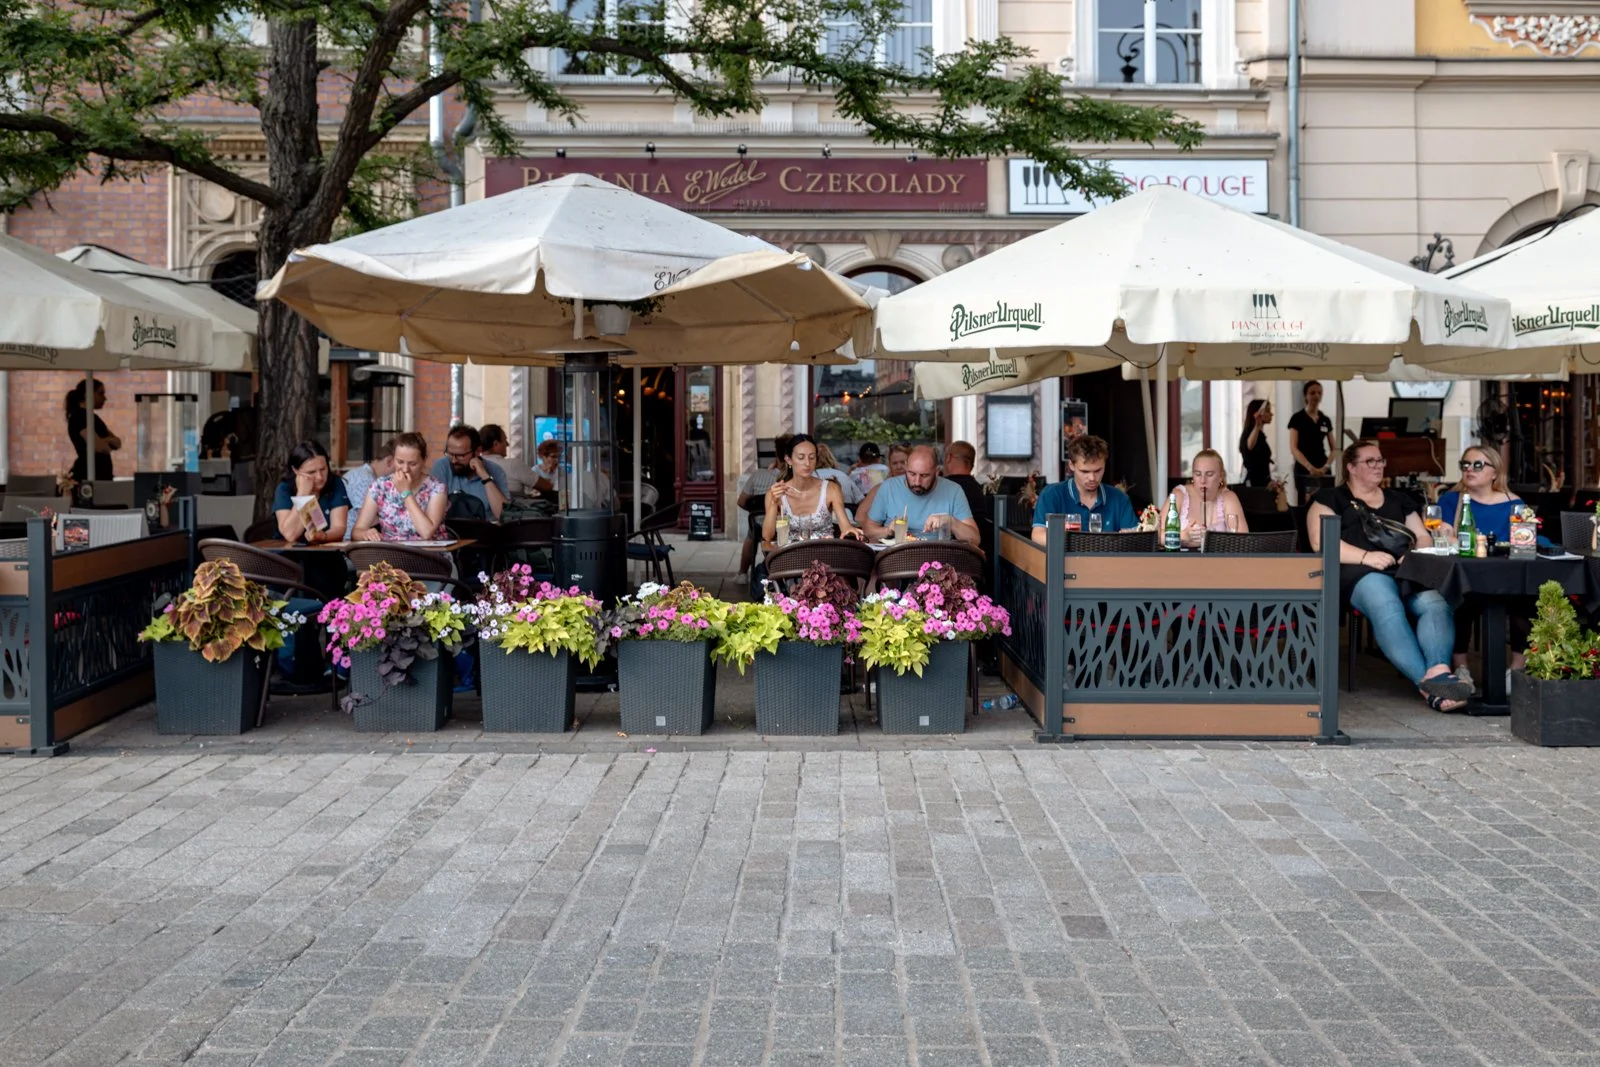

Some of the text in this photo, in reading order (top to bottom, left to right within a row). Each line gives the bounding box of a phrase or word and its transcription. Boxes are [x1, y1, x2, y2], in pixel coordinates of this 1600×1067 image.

[520, 166, 672, 193] PNIA
[779, 166, 966, 193] CZEKOLADY
[950, 299, 1042, 342] Pilsner Urquell
[1512, 304, 1600, 333] ilsner Urquell
[962, 357, 1018, 391] Pilsner Urquell
